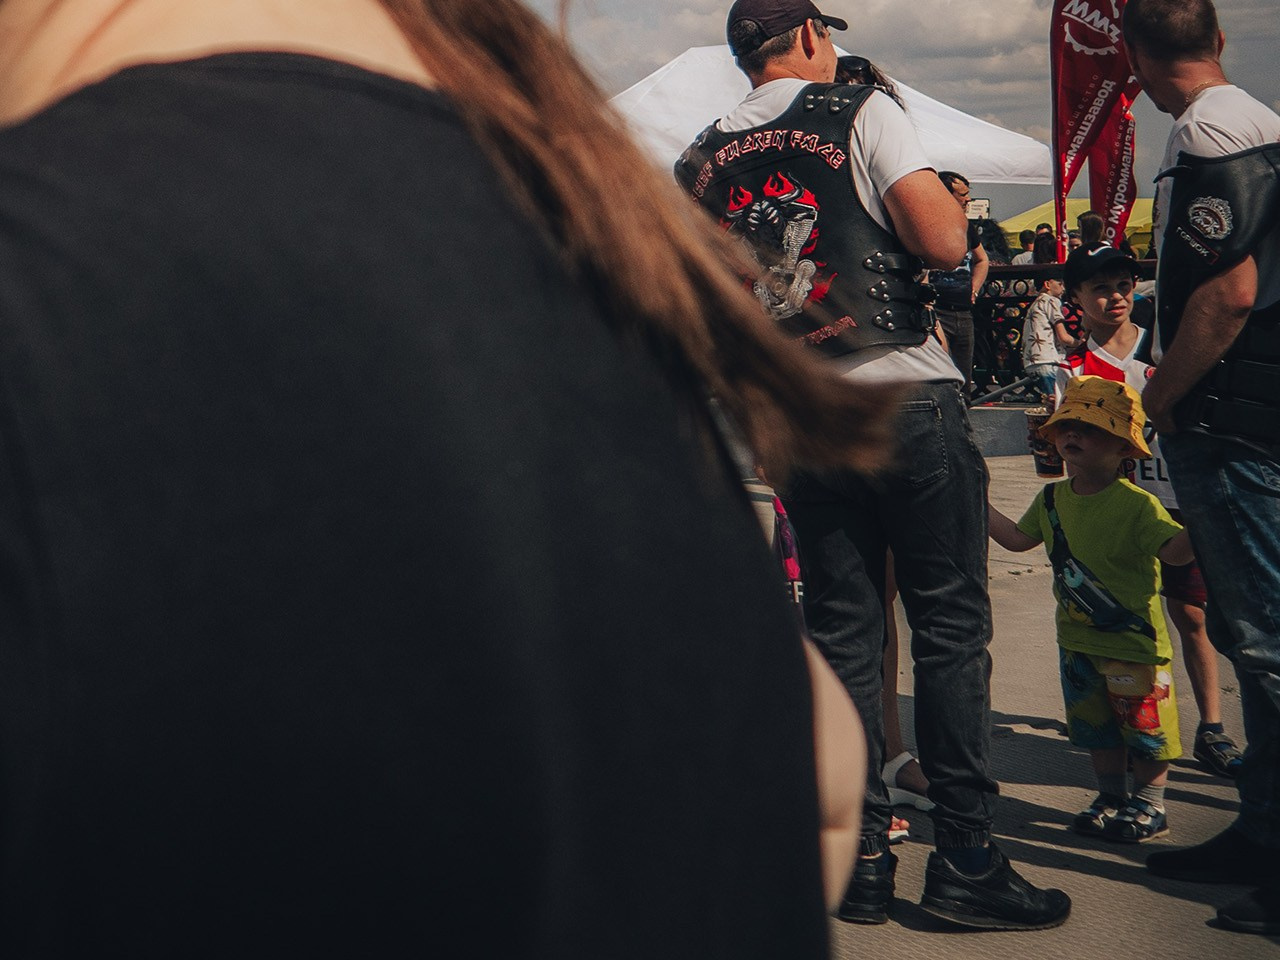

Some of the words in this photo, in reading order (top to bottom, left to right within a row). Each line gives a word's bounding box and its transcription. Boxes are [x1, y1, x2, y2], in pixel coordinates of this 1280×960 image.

[715, 129, 789, 167] FUCKEN
[790, 129, 847, 170] FACE
[1119, 457, 1169, 483] PEL
